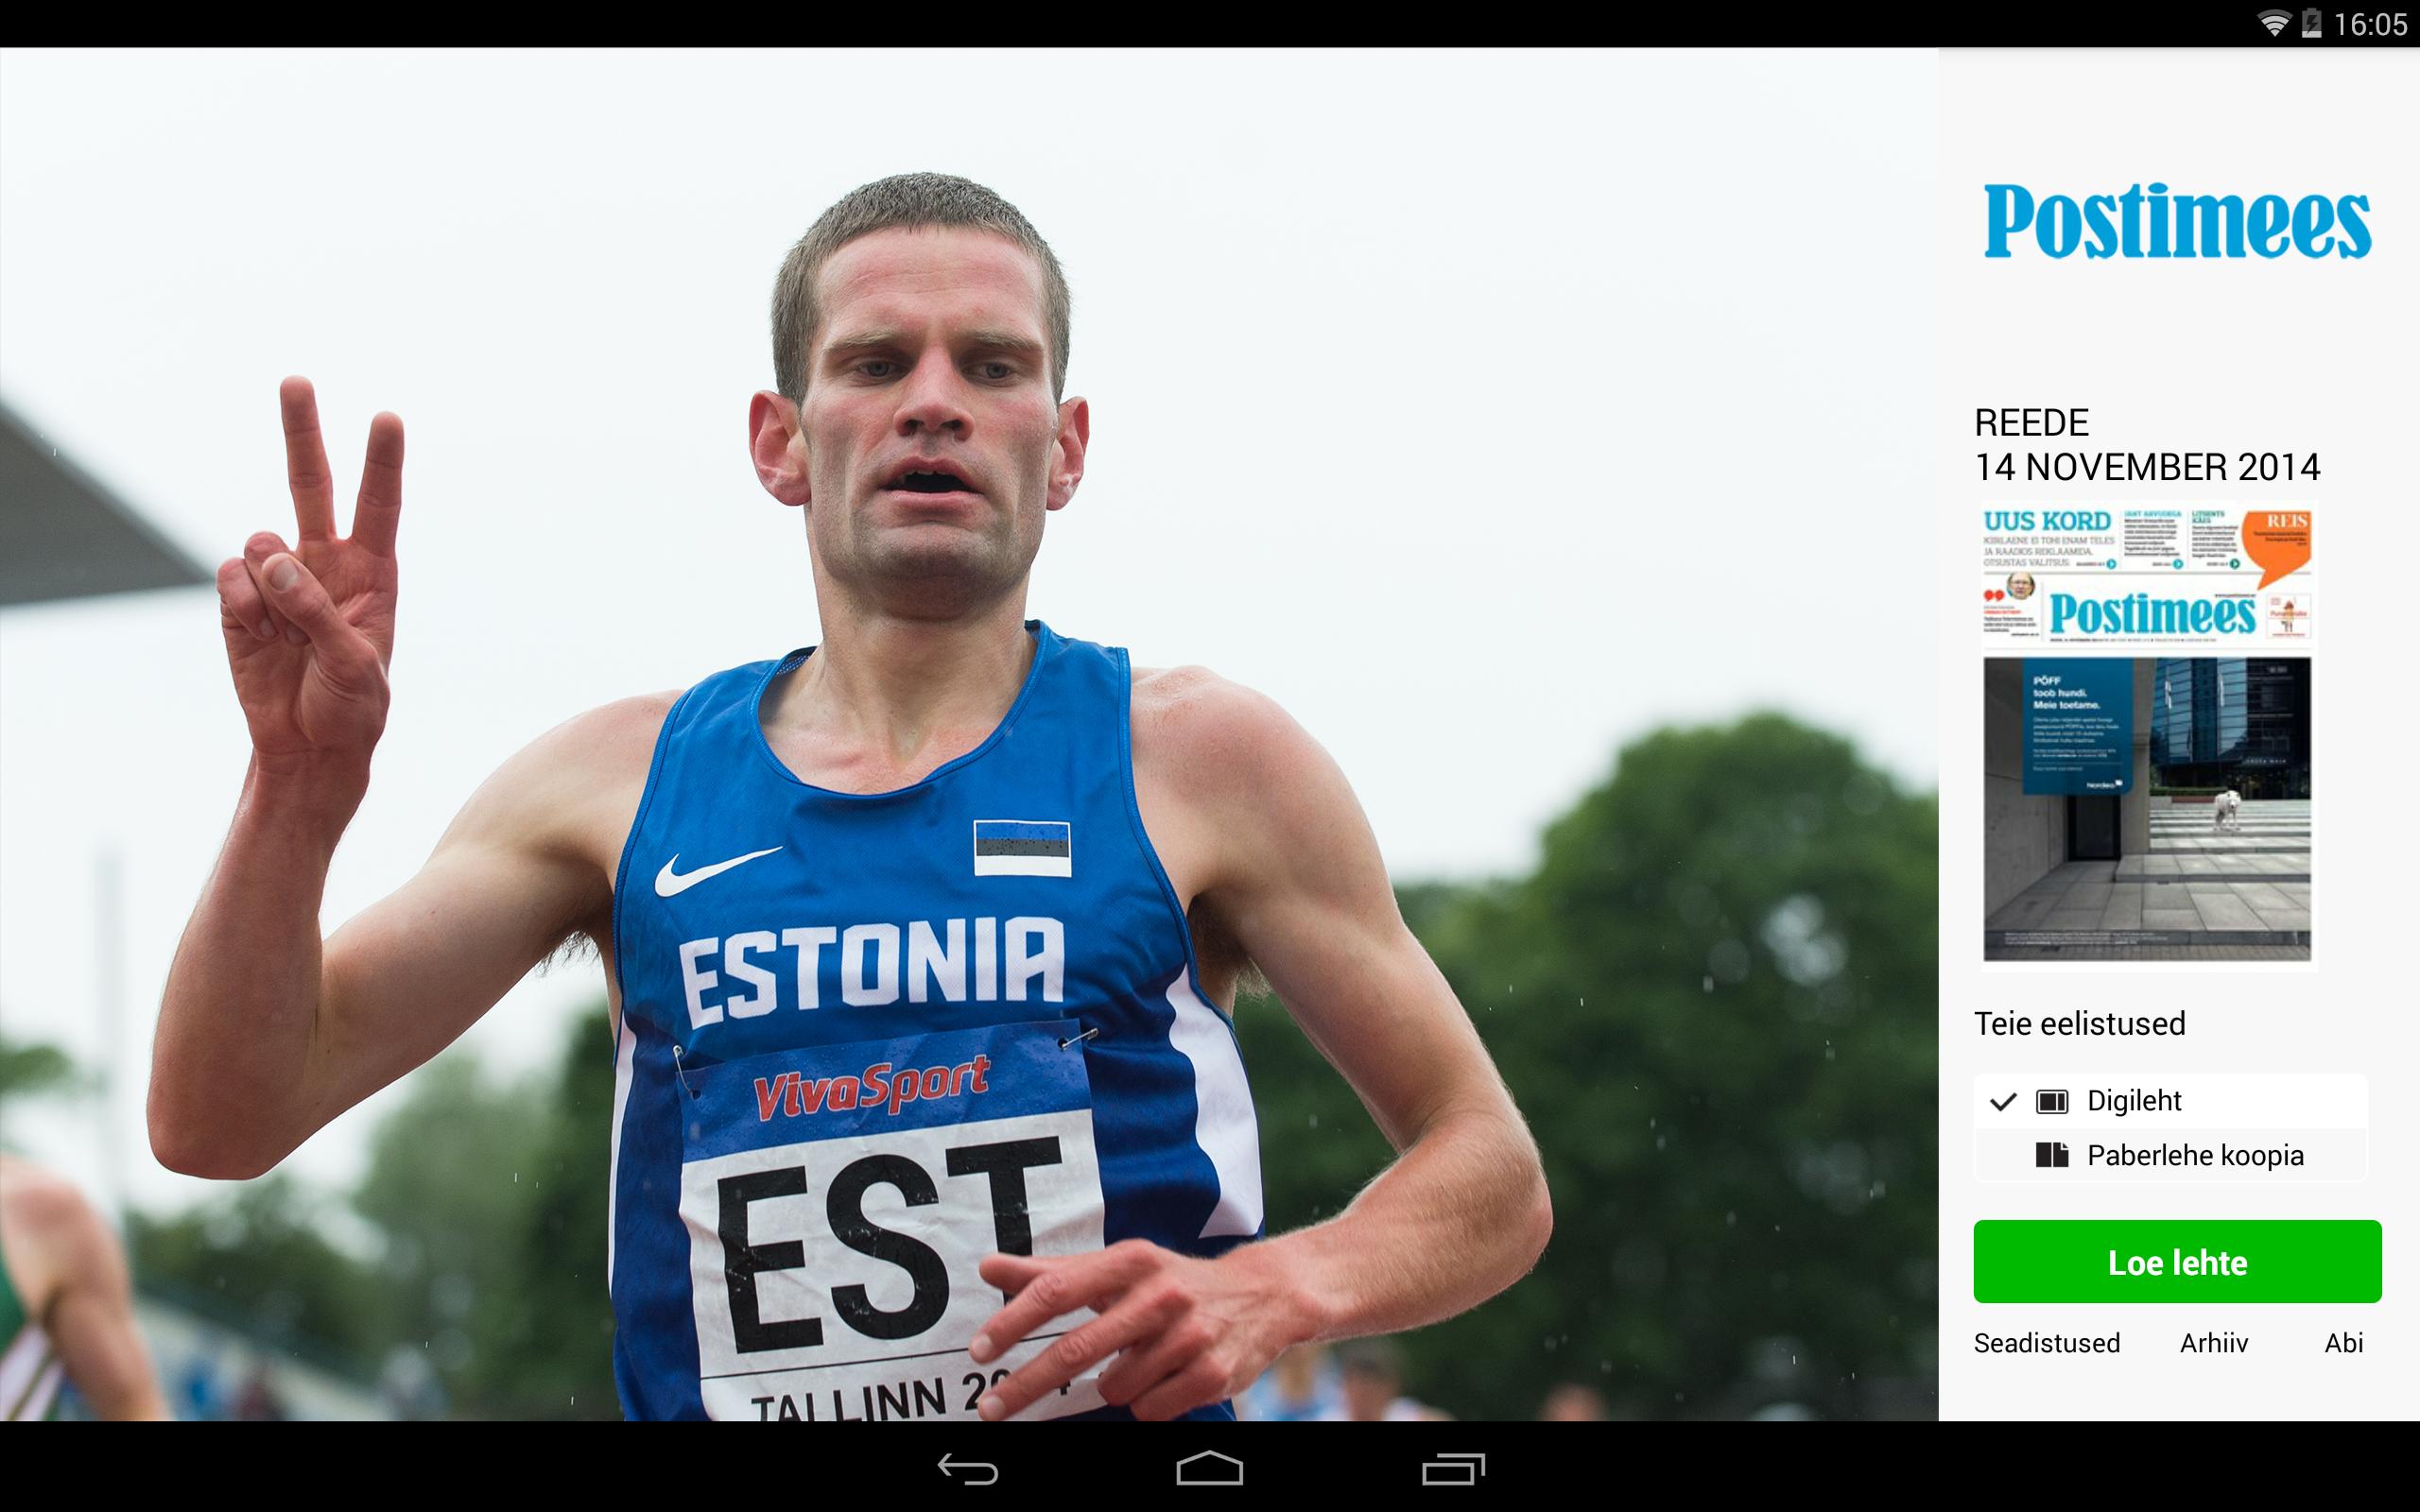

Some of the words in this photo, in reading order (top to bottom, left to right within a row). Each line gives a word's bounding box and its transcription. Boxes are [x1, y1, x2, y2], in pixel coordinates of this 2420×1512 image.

[2335, 12, 2409, 37] 16:05
[1984, 182, 2373, 260] Postimees
[1976, 407, 2090, 437] REEDE
[1977, 453, 2016, 481] 14
[2028, 453, 2228, 481] NOVEMBER
[2238, 453, 2322, 481] 2014
[1984, 511, 2035, 531] UUS
[2042, 511, 2112, 531] KORD
[2268, 514, 2308, 528] REIS
[2062, 537, 2088, 545] ENAM
[2049, 593, 2256, 634] Postimees
[2033, 700, 2057, 710] Meie
[679, 917, 1064, 1030] ESTONIA
[1975, 1010, 2032, 1037] Teie
[2040, 1009, 2186, 1037] eelistused
[753, 1054, 992, 1123] VivaSport
[2088, 1088, 2183, 1117] Digileht
[2088, 1143, 2214, 1167] Paberlehe
[2221, 1143, 2305, 1172] koopia
[717, 1136, 1062, 1353] EST
[2109, 1249, 2164, 1277] Loe
[2173, 1247, 2249, 1277] lehte
[1974, 1331, 2120, 1354] Seadistused
[2180, 1331, 2250, 1353] Arhiiv
[2324, 1331, 2363, 1354] Abi
[752, 1377, 946, 1421] TALLINN
